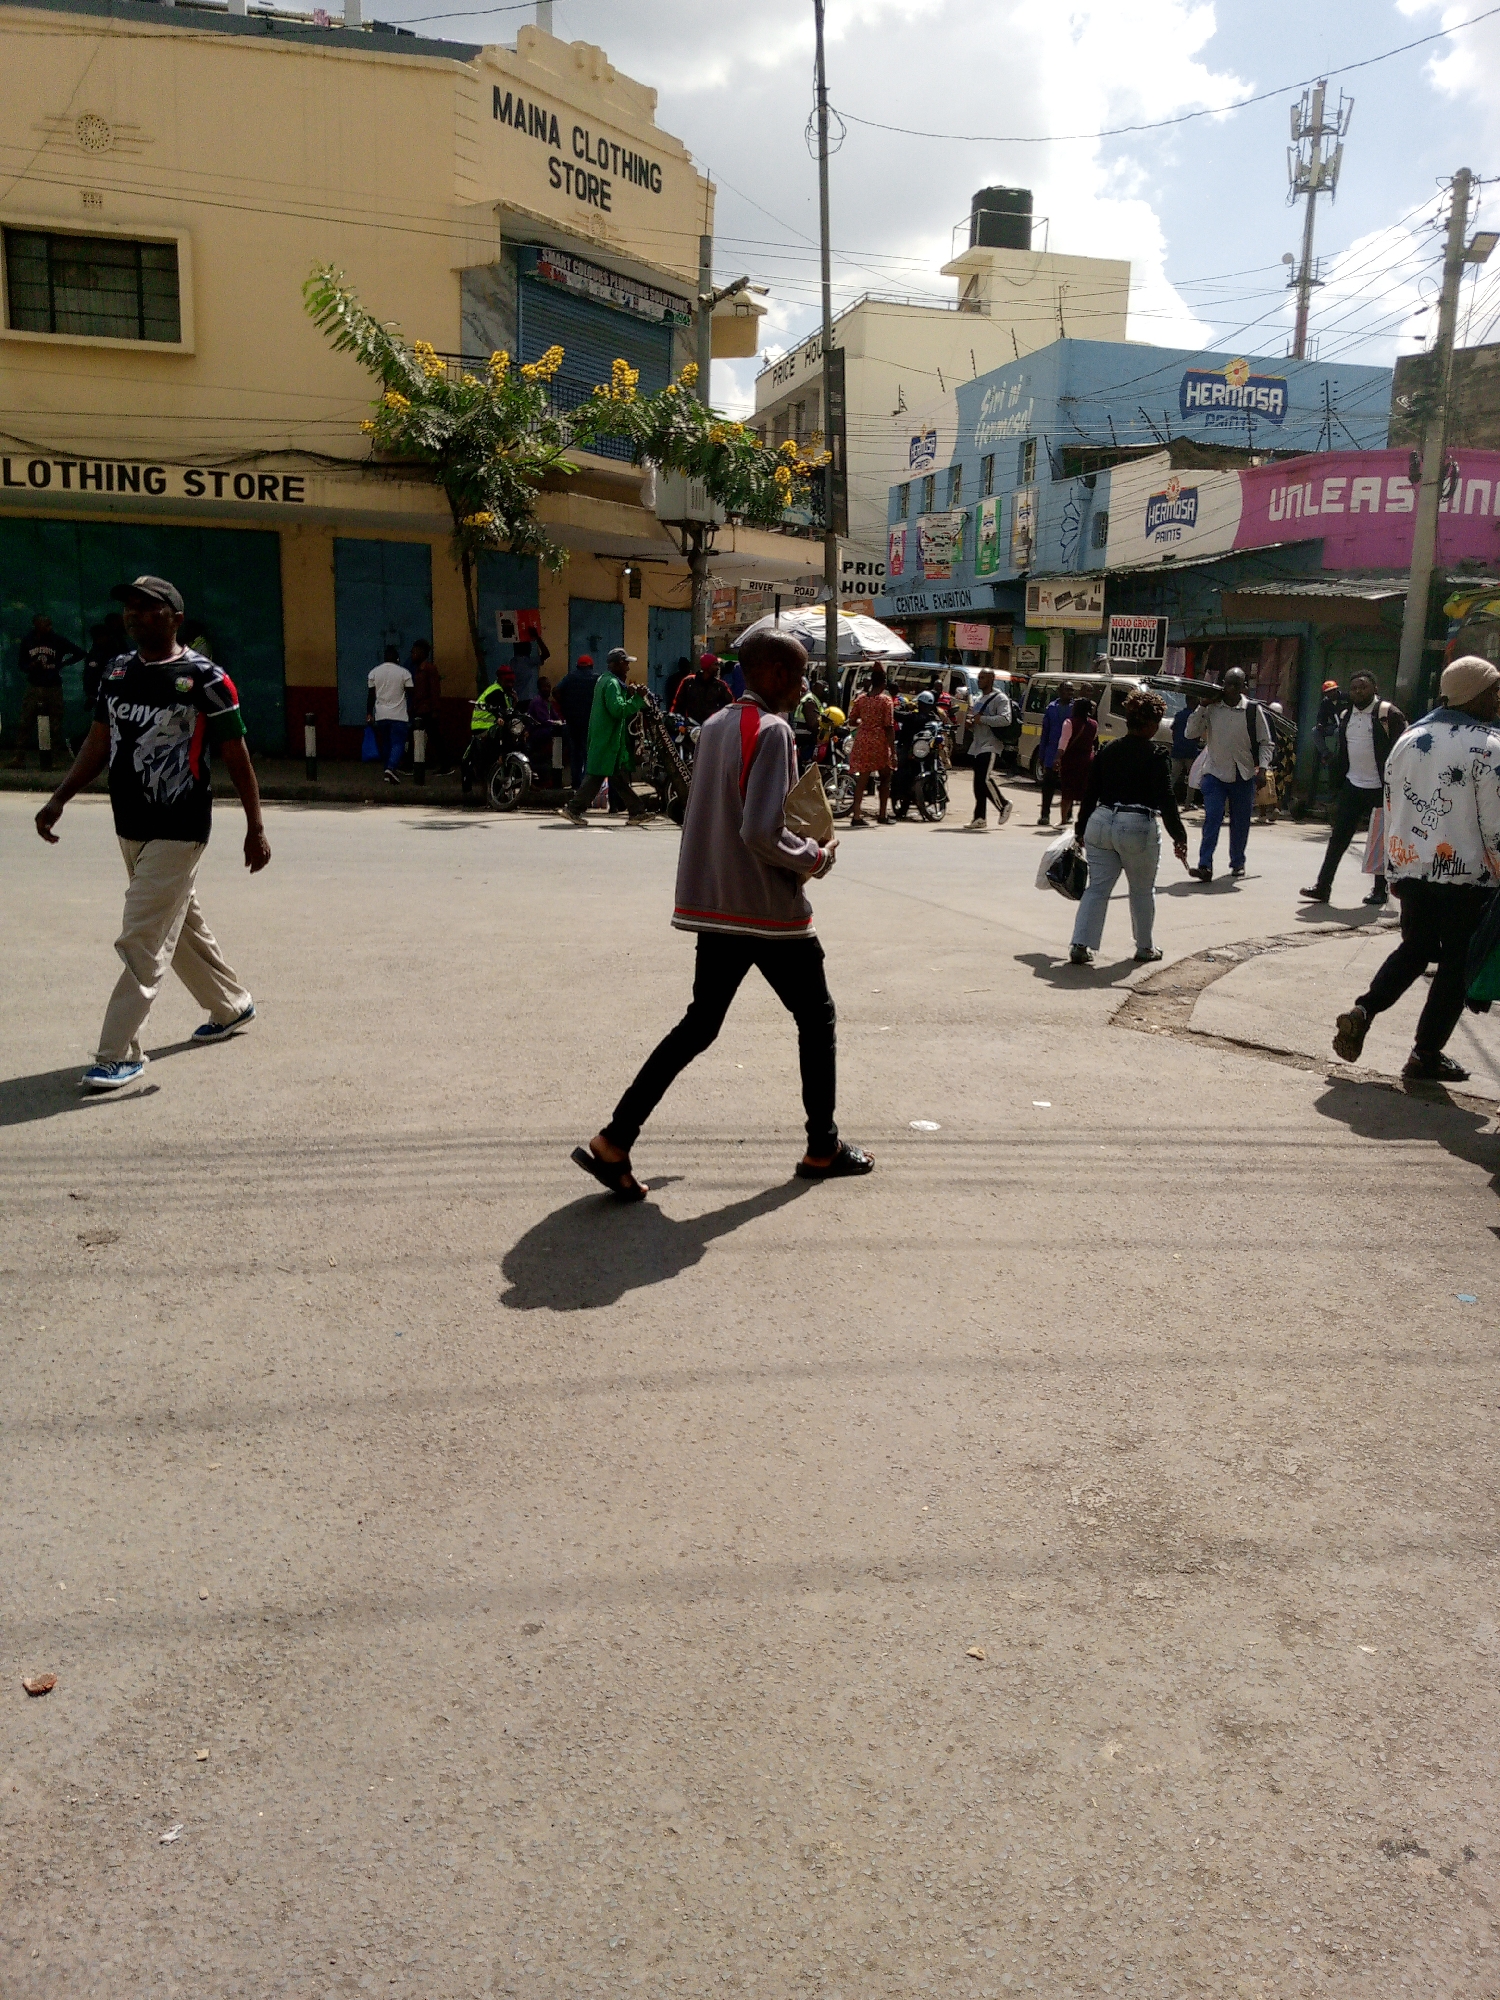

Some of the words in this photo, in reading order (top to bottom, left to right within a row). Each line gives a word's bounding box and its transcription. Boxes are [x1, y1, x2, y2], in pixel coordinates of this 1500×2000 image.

[493, 85, 561, 149] MAINA
[572, 126, 662, 194] CLOTHING
[548, 156, 611, 212] STORE
[772, 356, 796, 389] PRICE
[1185, 381, 1283, 415] HERMOSA
[2, 458, 166, 495] LOTHING
[184, 470, 305, 503] STORE
[1148, 498, 1196, 528] HERMOSA
[1154, 528, 1181, 543] PAINTS
[842, 561, 886, 576] PRIC
[749, 581, 774, 592] RIVER
[793, 586, 815, 597] ROAD
[896, 594, 929, 613] CENTRAL
[933, 590, 972, 610] EXHIBITION
[1111, 618, 1132, 627] MOLO
[1133, 618, 1157, 628] GROUP
[1111, 627, 1156, 643] NAKURU
[1110, 643, 1154, 658] DIRECT
[107, 695, 174, 728] Kenya
